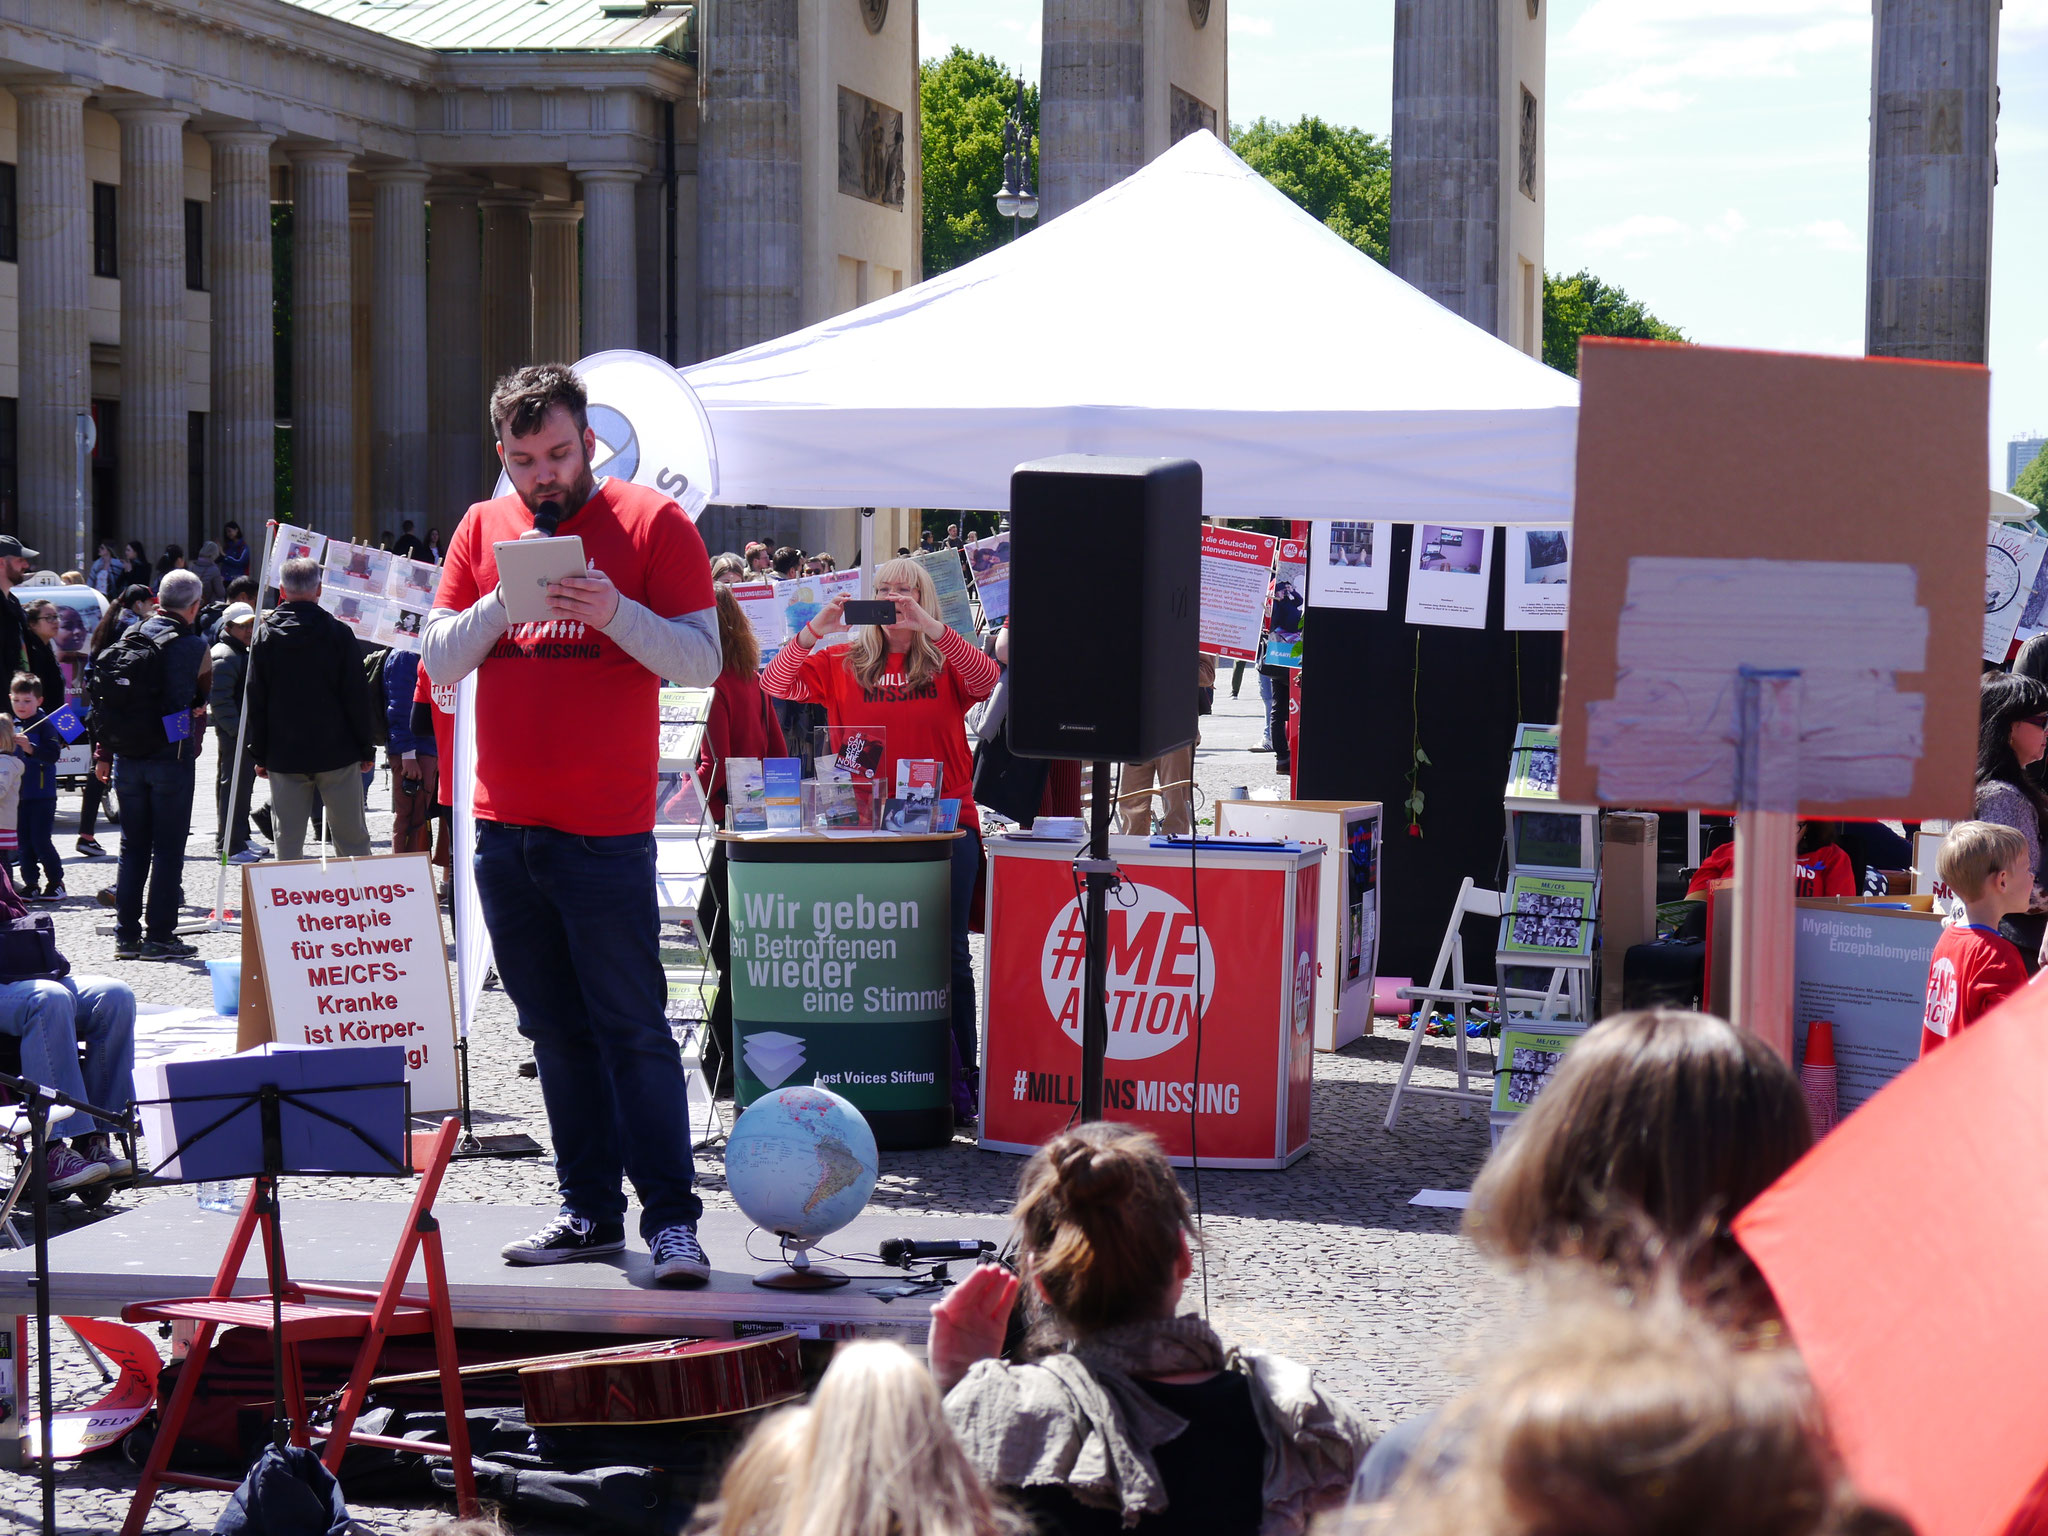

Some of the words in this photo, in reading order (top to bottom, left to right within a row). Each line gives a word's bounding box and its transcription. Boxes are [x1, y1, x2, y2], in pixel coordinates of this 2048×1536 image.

[1201, 545, 1259, 560] ntenversicherer
[1205, 535, 1218, 545] die
[1218, 537, 1257, 551] deutschen
[488, 643, 601, 659] LLIONSMISSING
[65, 686, 82, 695] hen
[863, 682, 938, 703] MISSING
[847, 741, 863, 752] YOU
[848, 736, 865, 746] CAN
[57, 756, 81, 764] axi.de
[837, 757, 861, 769] NOW?
[845, 748, 860, 758] SEE
[271, 883, 415, 906] Bewegungs-
[1541, 882, 1566, 890] ME/CFS
[297, 909, 391, 932] therapie
[812, 893, 919, 938] geben
[1802, 918, 1872, 939] Myalgische
[291, 940, 324, 961] für
[331, 937, 413, 958] schwer
[755, 933, 897, 959] Betroffenen
[1051, 907, 1203, 988] #ME
[1829, 938, 1934, 963] Enzephalomyeliti
[307, 962, 407, 987] ME/CFS-
[747, 953, 857, 989] wieder
[317, 992, 398, 1015] Kranke
[802, 986, 854, 1012] eine
[1058, 987, 1206, 1036] ATION
[304, 1025, 333, 1044] ist
[339, 1020, 425, 1043] Körper-
[1536, 1038, 1560, 1046] ME/CFS
[404, 1045, 429, 1069] ng!
[844, 1071, 887, 1085] Voices
[890, 1071, 935, 1085] Stiftung
[1013, 1070, 1240, 1115] #MILLNSMISSING
